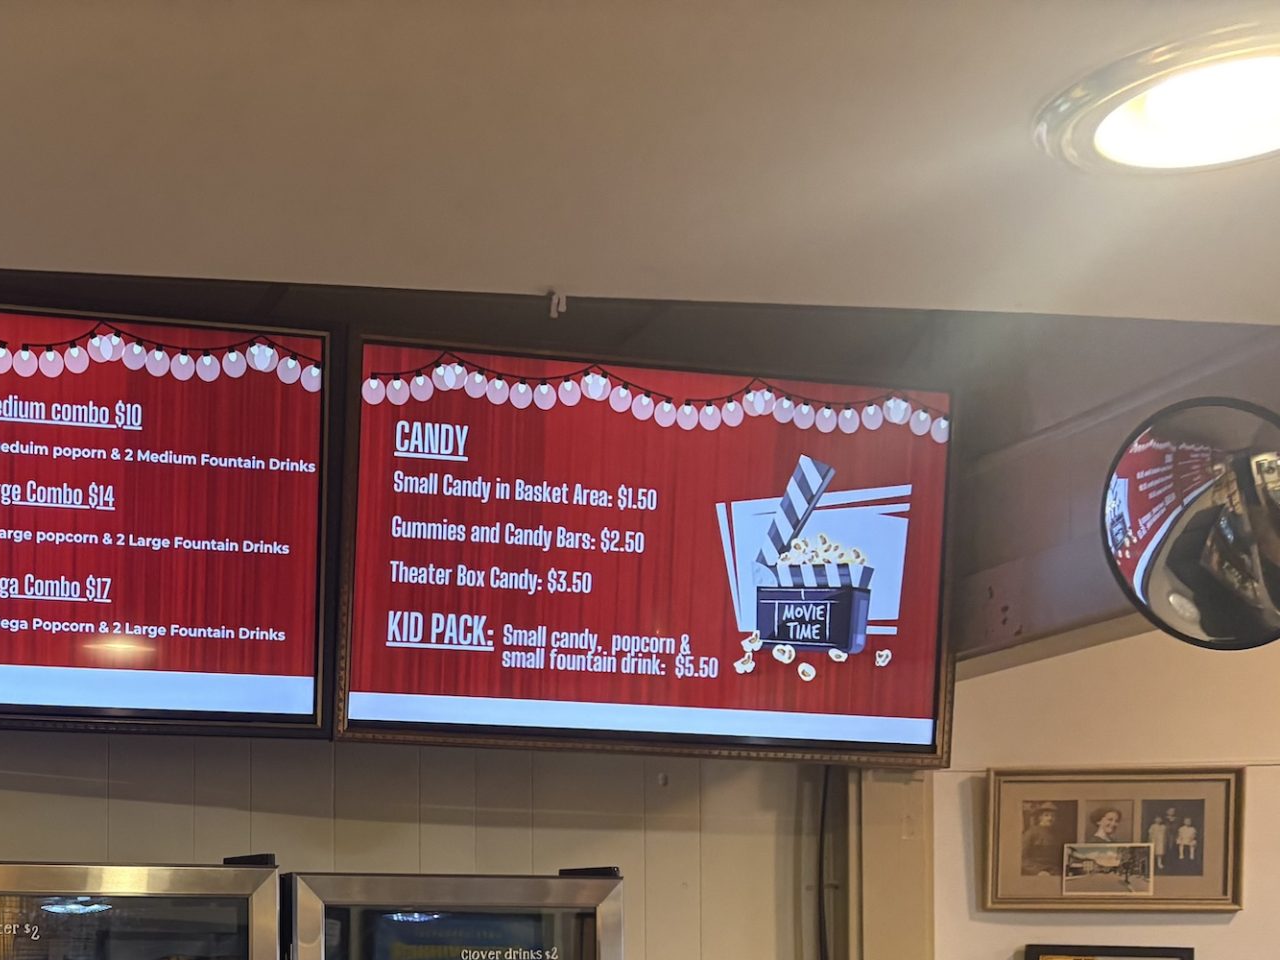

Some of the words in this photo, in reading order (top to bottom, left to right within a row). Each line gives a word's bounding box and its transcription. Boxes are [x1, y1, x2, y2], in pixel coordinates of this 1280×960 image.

[51, 399, 110, 427] combo
[114, 399, 143, 429] $10
[395, 420, 469, 456] CANDY
[52, 445, 107, 462] poporn
[110, 447, 122, 462] &
[124, 448, 135, 462] 2
[136, 449, 198, 467] Medium
[200, 453, 266, 471] Fountain
[269, 457, 317, 474] Drinks
[26, 480, 84, 507] Combo
[88, 481, 115, 509] $14
[393, 470, 439, 496] Small
[442, 474, 491, 503] Candy
[495, 476, 511, 500] in
[514, 478, 569, 505] Basket
[572, 483, 613, 508] Area:
[617, 484, 658, 511] $1.50
[35, 529, 99, 547] popcorn
[102, 532, 114, 546] &
[116, 532, 126, 546] 2
[128, 533, 172, 551] Large
[173, 536, 239, 553] Fountain
[242, 539, 290, 555] Drinks
[391, 515, 467, 542] Gummies
[470, 522, 501, 545] and
[504, 522, 552, 552] Candy
[556, 526, 596, 551] Bars:
[600, 526, 645, 554] $2.50
[23, 573, 81, 600] Combo
[85, 574, 112, 602] $17
[390, 560, 453, 586] Theater
[456, 564, 485, 588] Box
[489, 566, 543, 596] Candy:
[547, 567, 593, 595] $3.50
[782, 604, 826, 622] MOVIE
[32, 617, 95, 634] Popcorn
[98, 620, 110, 634] &
[112, 620, 122, 634] 2
[124, 621, 167, 638] Large
[170, 623, 236, 640] Fountain
[238, 627, 286, 642] Drinks
[387, 610, 424, 643] KID
[430, 612, 495, 648] PACK:
[502, 623, 547, 650] Small
[550, 627, 604, 655] candy,
[611, 633, 676, 656] popcorn
[680, 633, 692, 655] &
[786, 621, 821, 640] TIME
[501, 648, 546, 671] small
[549, 650, 617, 674] fountain
[620, 652, 667, 676] drink:
[674, 654, 719, 679] $5.50
[24, 922, 41, 941] $2
[504, 947, 543, 960] drinks
[545, 946, 559, 960] $2
